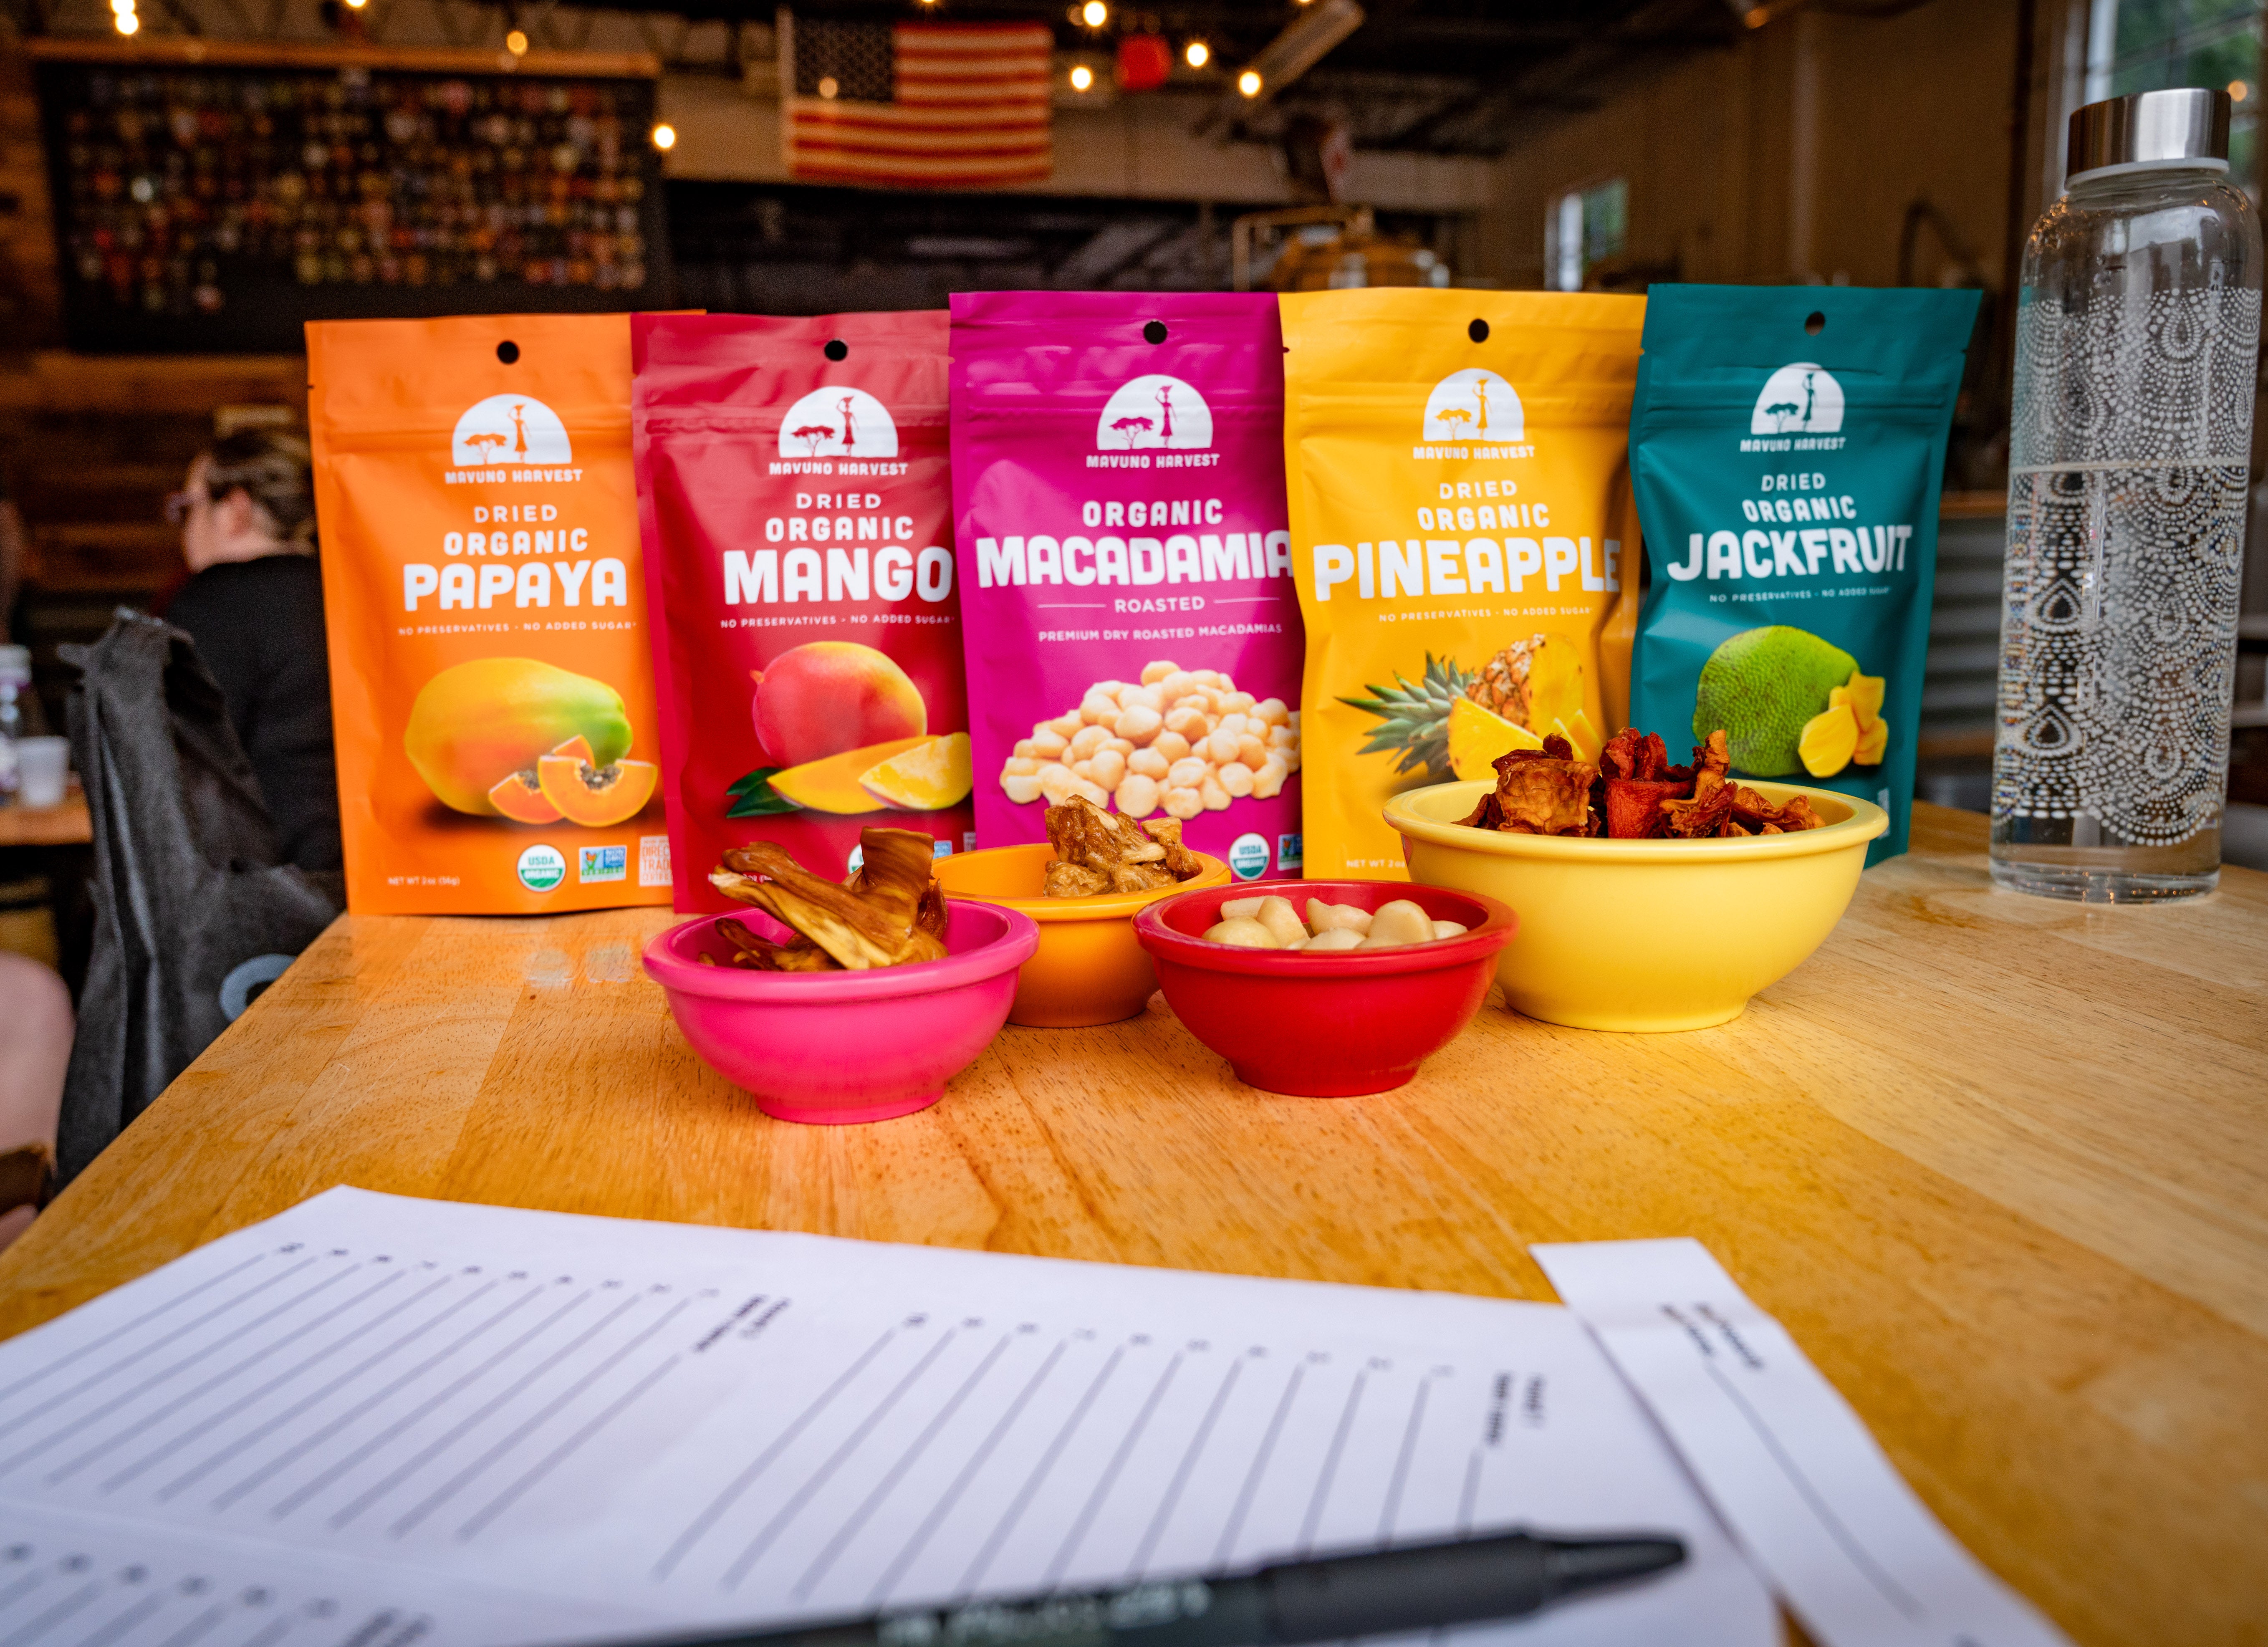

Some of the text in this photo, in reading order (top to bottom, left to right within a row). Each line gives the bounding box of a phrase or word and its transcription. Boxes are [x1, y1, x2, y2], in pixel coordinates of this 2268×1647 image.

[1414, 445, 1535, 460] MAVUNO HARVEST
[1740, 437, 1846, 452] MAVUNO HARVEST
[769, 462, 908, 475] MAVUNO HARVEST
[1086, 454, 1220, 468] MAVUNO HARVEST
[445, 469, 583, 484] MAVUNO HARVEST
[1761, 472, 1826, 492] DRIED
[1440, 480, 1517, 500] DRIED
[796, 493, 881, 509] DRIED
[1742, 495, 1857, 523] ORGANIC
[474, 505, 558, 523] DRIED
[1082, 498, 1223, 527] ORGANIC
[1417, 503, 1550, 531] ORGANIC
[765, 516, 914, 543] ORGANIC
[443, 528, 588, 556] ORGANIC
[976, 530, 1293, 588] MACADAMIA
[1667, 524, 1913, 581] JACKFRUIT
[723, 546, 953, 605] MANGO
[1313, 536, 1621, 602] PINEAPPLE
[403, 558, 627, 611] PAPAYA
[1732, 589, 1812, 602] PRESERVATIVES
[1821, 589, 1835, 597] NO
[1838, 587, 1867, 596] ADDED
[1114, 596, 1205, 613] ROASTED
[720, 619, 737, 628] NO
[741, 615, 836, 627] PRESERVATIVES
[850, 614, 868, 624] NO
[873, 614, 912, 624] ADDED
[1401, 609, 1491, 621] PRESERVATIVES
[1503, 608, 1518, 616] NO
[1523, 607, 1556, 616] ADDED
[398, 627, 414, 636] NO
[417, 623, 510, 634] PRESERVATIVES
[523, 621, 540, 631] NO
[545, 621, 587, 631] ADDED
[1038, 623, 1283, 642] PREMIUM DRY ROASTED MACADAMIAS
[642, 846, 669, 857] DIREC
[1239, 845, 1261, 854] USDA
[528, 855, 555, 865] USDA
[643, 859, 671, 871] TRAD
[1346, 859, 1365, 868] NET
[1369, 859, 1385, 868] WT
[388, 877, 404, 886] NET
[407, 876, 419, 885] WT
